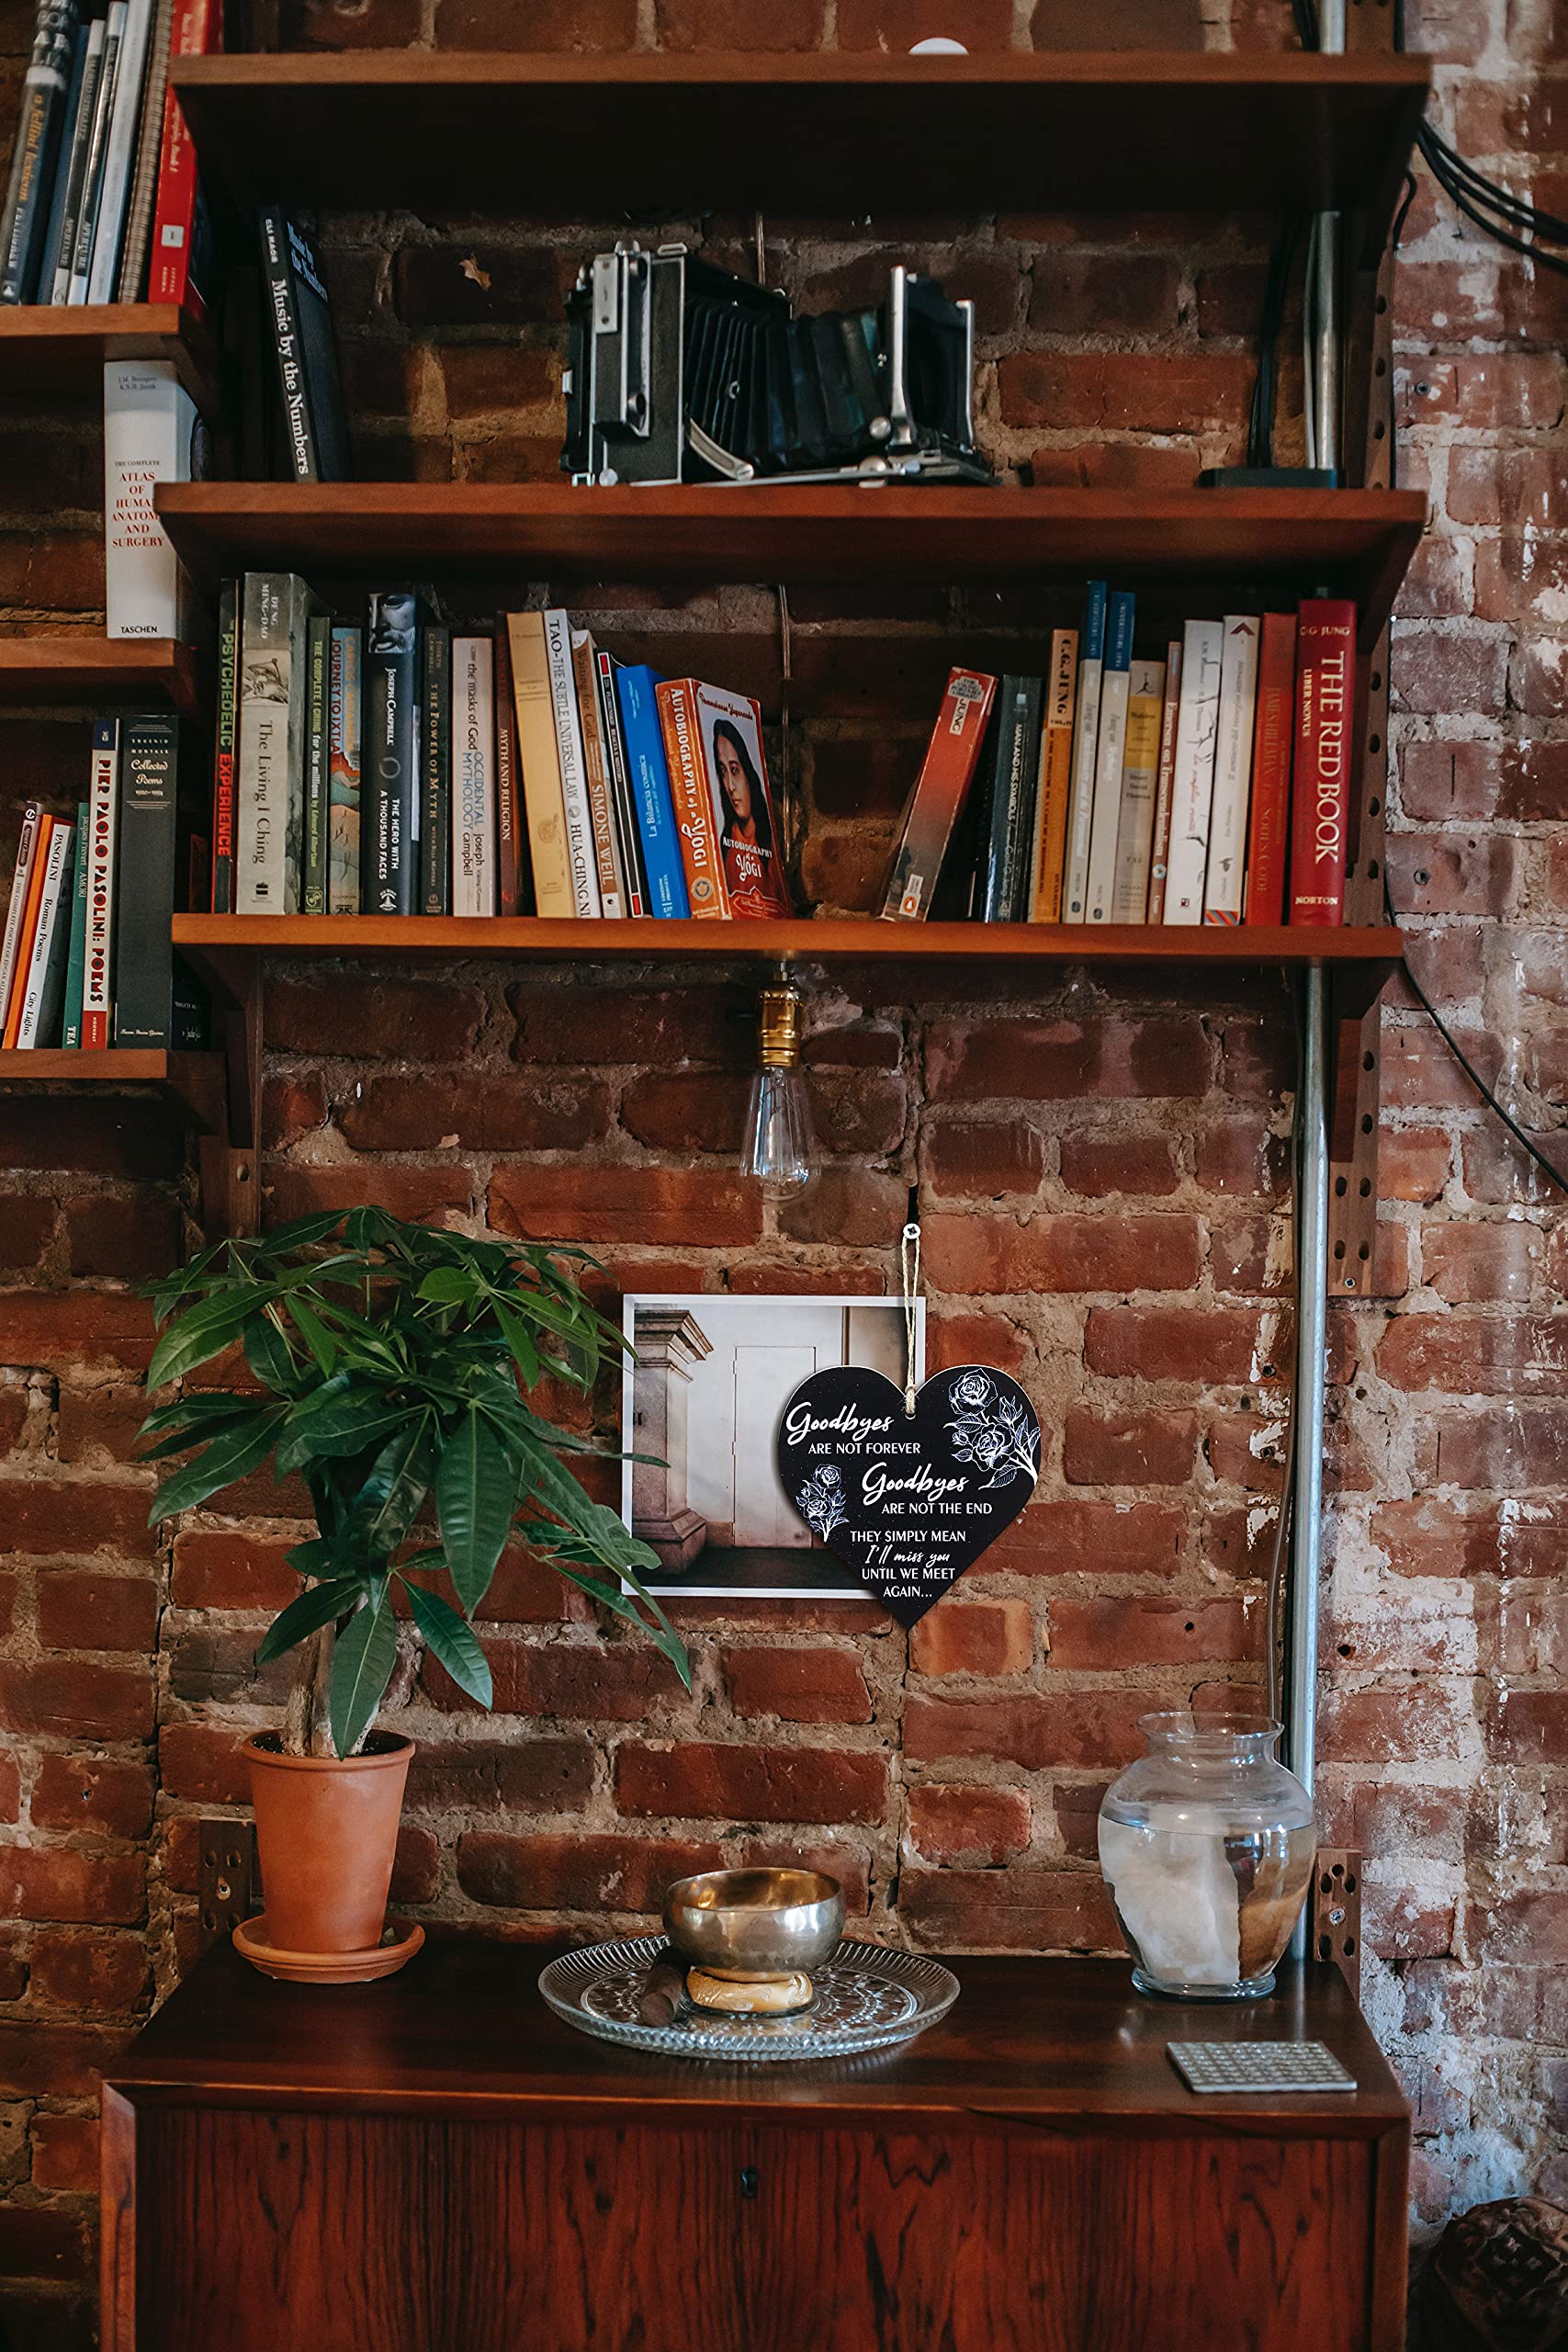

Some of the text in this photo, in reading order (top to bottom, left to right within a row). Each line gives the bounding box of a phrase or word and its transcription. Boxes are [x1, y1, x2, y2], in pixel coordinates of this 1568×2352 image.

[18, 94, 44, 203] a fellini lexicon
[59, 217, 74, 266] APERTURE
[265, 219, 274, 234] ELI
[76, 220, 92, 269] APERTURE
[271, 278, 310, 475] Music by the Numbers
[118, 471, 156, 482] ATLAS
[129, 484, 145, 495] OF
[111, 511, 160, 523] ANATOM
[115, 498, 154, 509] HUMA
[111, 537, 164, 548] SURGERY
[124, 525, 150, 534] AND
[259, 582, 269, 639] MING-DAO
[269, 596, 279, 626] DENG
[120, 626, 158, 634] TASCHEN
[1320, 626, 1351, 637] JUNG
[312, 641, 322, 656] THE
[344, 637, 356, 682] CARLOS
[312, 658, 322, 701] COMPLETE
[331, 637, 343, 696] JOURNEY
[467, 662, 479, 680] the
[574, 648, 592, 692] Waiting
[219, 633, 234, 747] PSYCHEDELIC
[331, 698, 342, 715] TO
[384, 667, 398, 746] JOSEPH CAMPBELL
[467, 681, 479, 713] masks
[553, 681, 570, 717] SUBTLE
[580, 693, 593, 710] for
[1056, 669, 1070, 715] JUNG
[1265, 687, 1281, 721] JAMES
[1303, 668, 1313, 737] LIBER NOVUS
[311, 708, 322, 732] CHING
[467, 713, 479, 727] of
[582, 713, 596, 740] God
[951, 698, 966, 733] JUNG
[257, 720, 273, 750] The
[311, 734, 321, 749] for
[428, 683, 440, 820] THE POWER OF MYTH
[467, 728, 479, 750] God
[558, 718, 575, 775] UNIVERSAL
[670, 687, 697, 795] AUTOBIOGRAPHY
[1263, 722, 1279, 775] HILLMAN
[130, 759, 169, 772] Collected
[311, 751, 321, 764] the
[638, 754, 650, 789] cosmica
[1007, 723, 1023, 821] MAN AND HIS SYMBOLS
[1314, 650, 1345, 865] THE RED BOOK
[97, 758, 111, 796] PIER
[135, 773, 164, 785] Poems
[254, 755, 273, 802] Living
[310, 766, 321, 798] millions
[462, 752, 474, 830] MYTHOLOGY
[474, 752, 485, 826] OCCIDENTAL
[500, 728, 512, 841] MYTH AND RELIGION
[563, 776, 579, 799] LAW
[1155, 701, 1178, 857] Emerson on Transcendentalism
[217, 752, 232, 856] EXPERIENCE
[591, 784, 610, 843] SIMONE
[643, 790, 656, 824] Bilancia
[686, 797, 695, 808] of
[95, 801, 110, 858] PAOLO
[310, 809, 319, 835] Edward
[378, 790, 389, 880] A THOUSAND FACES
[390, 798, 400, 870] THE HERO WITH
[648, 825, 658, 838] La
[19, 844, 29, 865] Classic
[253, 818, 271, 865] Ching
[310, 836, 319, 867] Albertson
[461, 831, 473, 876] campbell
[473, 831, 485, 866] joseph
[680, 817, 709, 868] YOGI
[722, 836, 773, 858] AUTOBIOGRAPHY
[570, 823, 592, 917] HUA-CHING NI
[596, 845, 615, 886] WEIL
[735, 854, 762, 882] YOGI
[1255, 854, 1273, 895] CODE
[15, 882, 23, 895] THE
[34, 832, 64, 963] PASOLINI Roman Poems
[78, 871, 88, 898] AMORI
[1295, 896, 1338, 906] NORTON
[9, 894, 20, 926] COMPLETE
[93, 865, 108, 943] PASOLINI:
[5, 950, 12, 958] OF
[6, 926, 15, 951] POETRY
[1, 958, 11, 981] EDGAR
[90, 947, 105, 1003] POEMS
[22, 991, 39, 1037] City Lights
[90, 1016, 99, 1043] NOONDAY
[65, 1025, 77, 1046] TEA
[785, 1401, 895, 1445] Goodbyes
[808, 1442, 921, 1454] ARE NOT FOREVER
[862, 1462, 969, 1506] Goodbyes
[881, 1503, 993, 1514] ARE NOT THE END
[850, 1531, 966, 1542] THEY SIMPLY MEAN
[864, 1544, 951, 1567] I'll miss you
[862, 1567, 955, 1580] UNTIL WE MEET
[883, 1586, 932, 1598] AGAIN...
